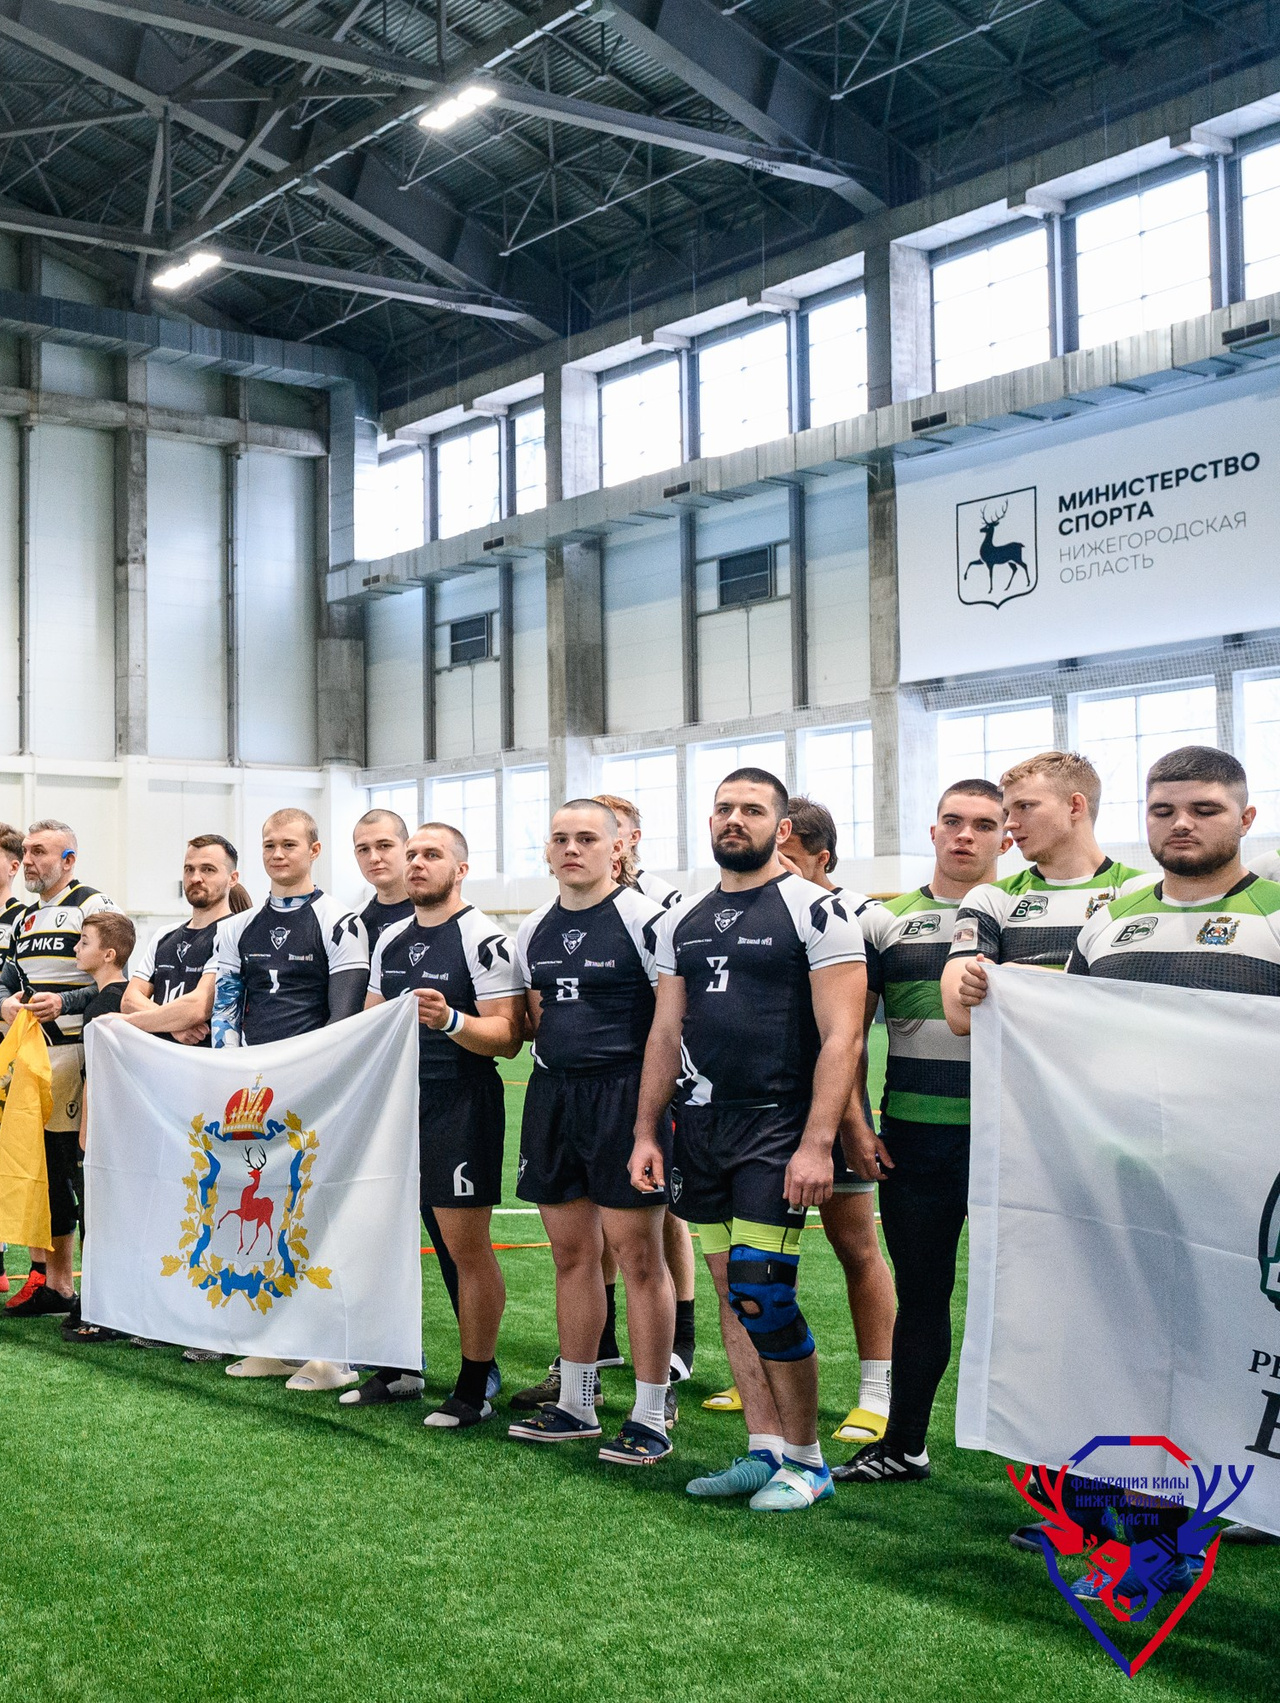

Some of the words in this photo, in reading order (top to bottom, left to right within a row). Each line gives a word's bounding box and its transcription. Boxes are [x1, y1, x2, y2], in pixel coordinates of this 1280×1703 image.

[1058, 451, 1260, 513] МИНИСТЕРСТВО
[1058, 500, 1154, 536] СПОРТА
[1059, 510, 1247, 563] НИЖЕГОРОДСКАЯ
[1060, 552, 1154, 584] ОБЛАСТЬ
[31, 937, 65, 952] МКБ
[705, 955, 730, 993] 3
[453, 1161, 475, 1197] 6
